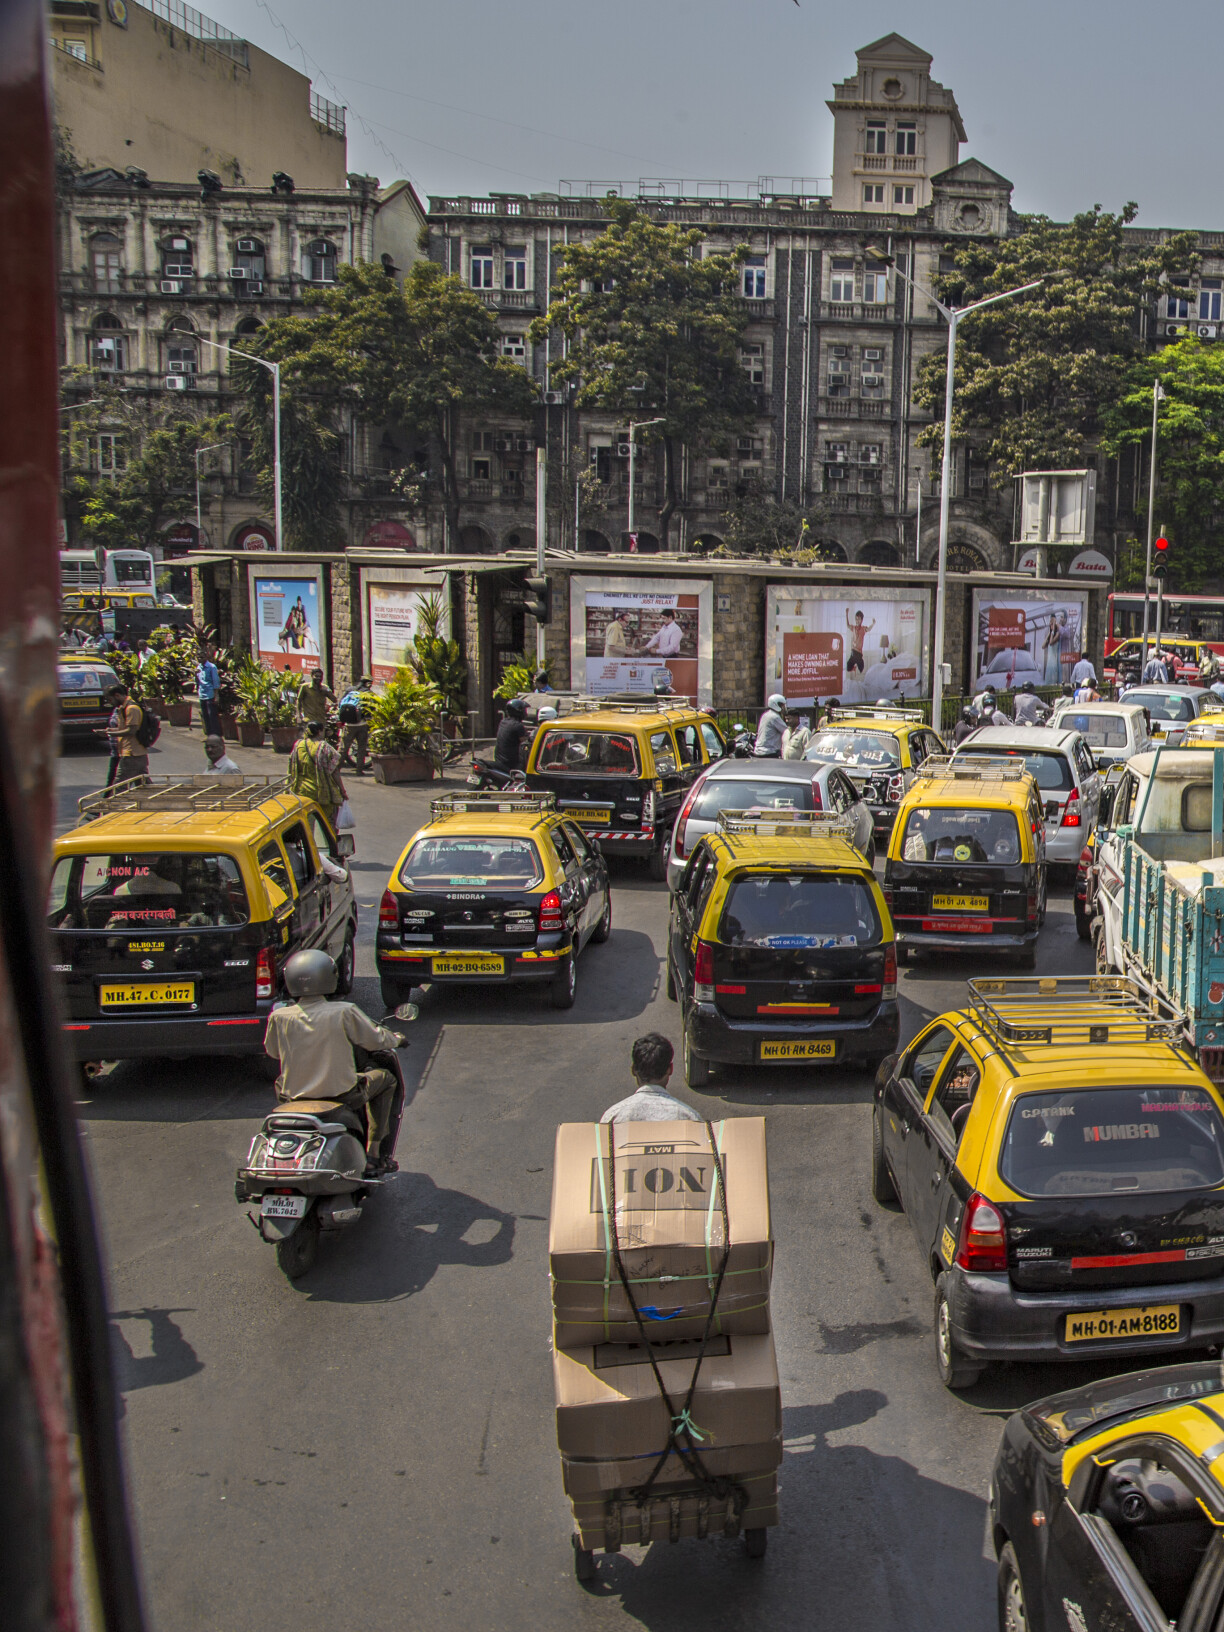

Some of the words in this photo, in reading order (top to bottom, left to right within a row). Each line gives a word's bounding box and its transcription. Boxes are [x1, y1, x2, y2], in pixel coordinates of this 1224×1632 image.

[1024, 559, 1037, 568] Ba
[1075, 561, 1107, 571] Bata
[818, 652, 829, 660] THAT
[788, 660, 804, 668] MAKES
[435, 963, 502, 972] MH-02-BQ-6589
[808, 1044, 831, 1055] 8469
[647, 1145, 672, 1154] MAT
